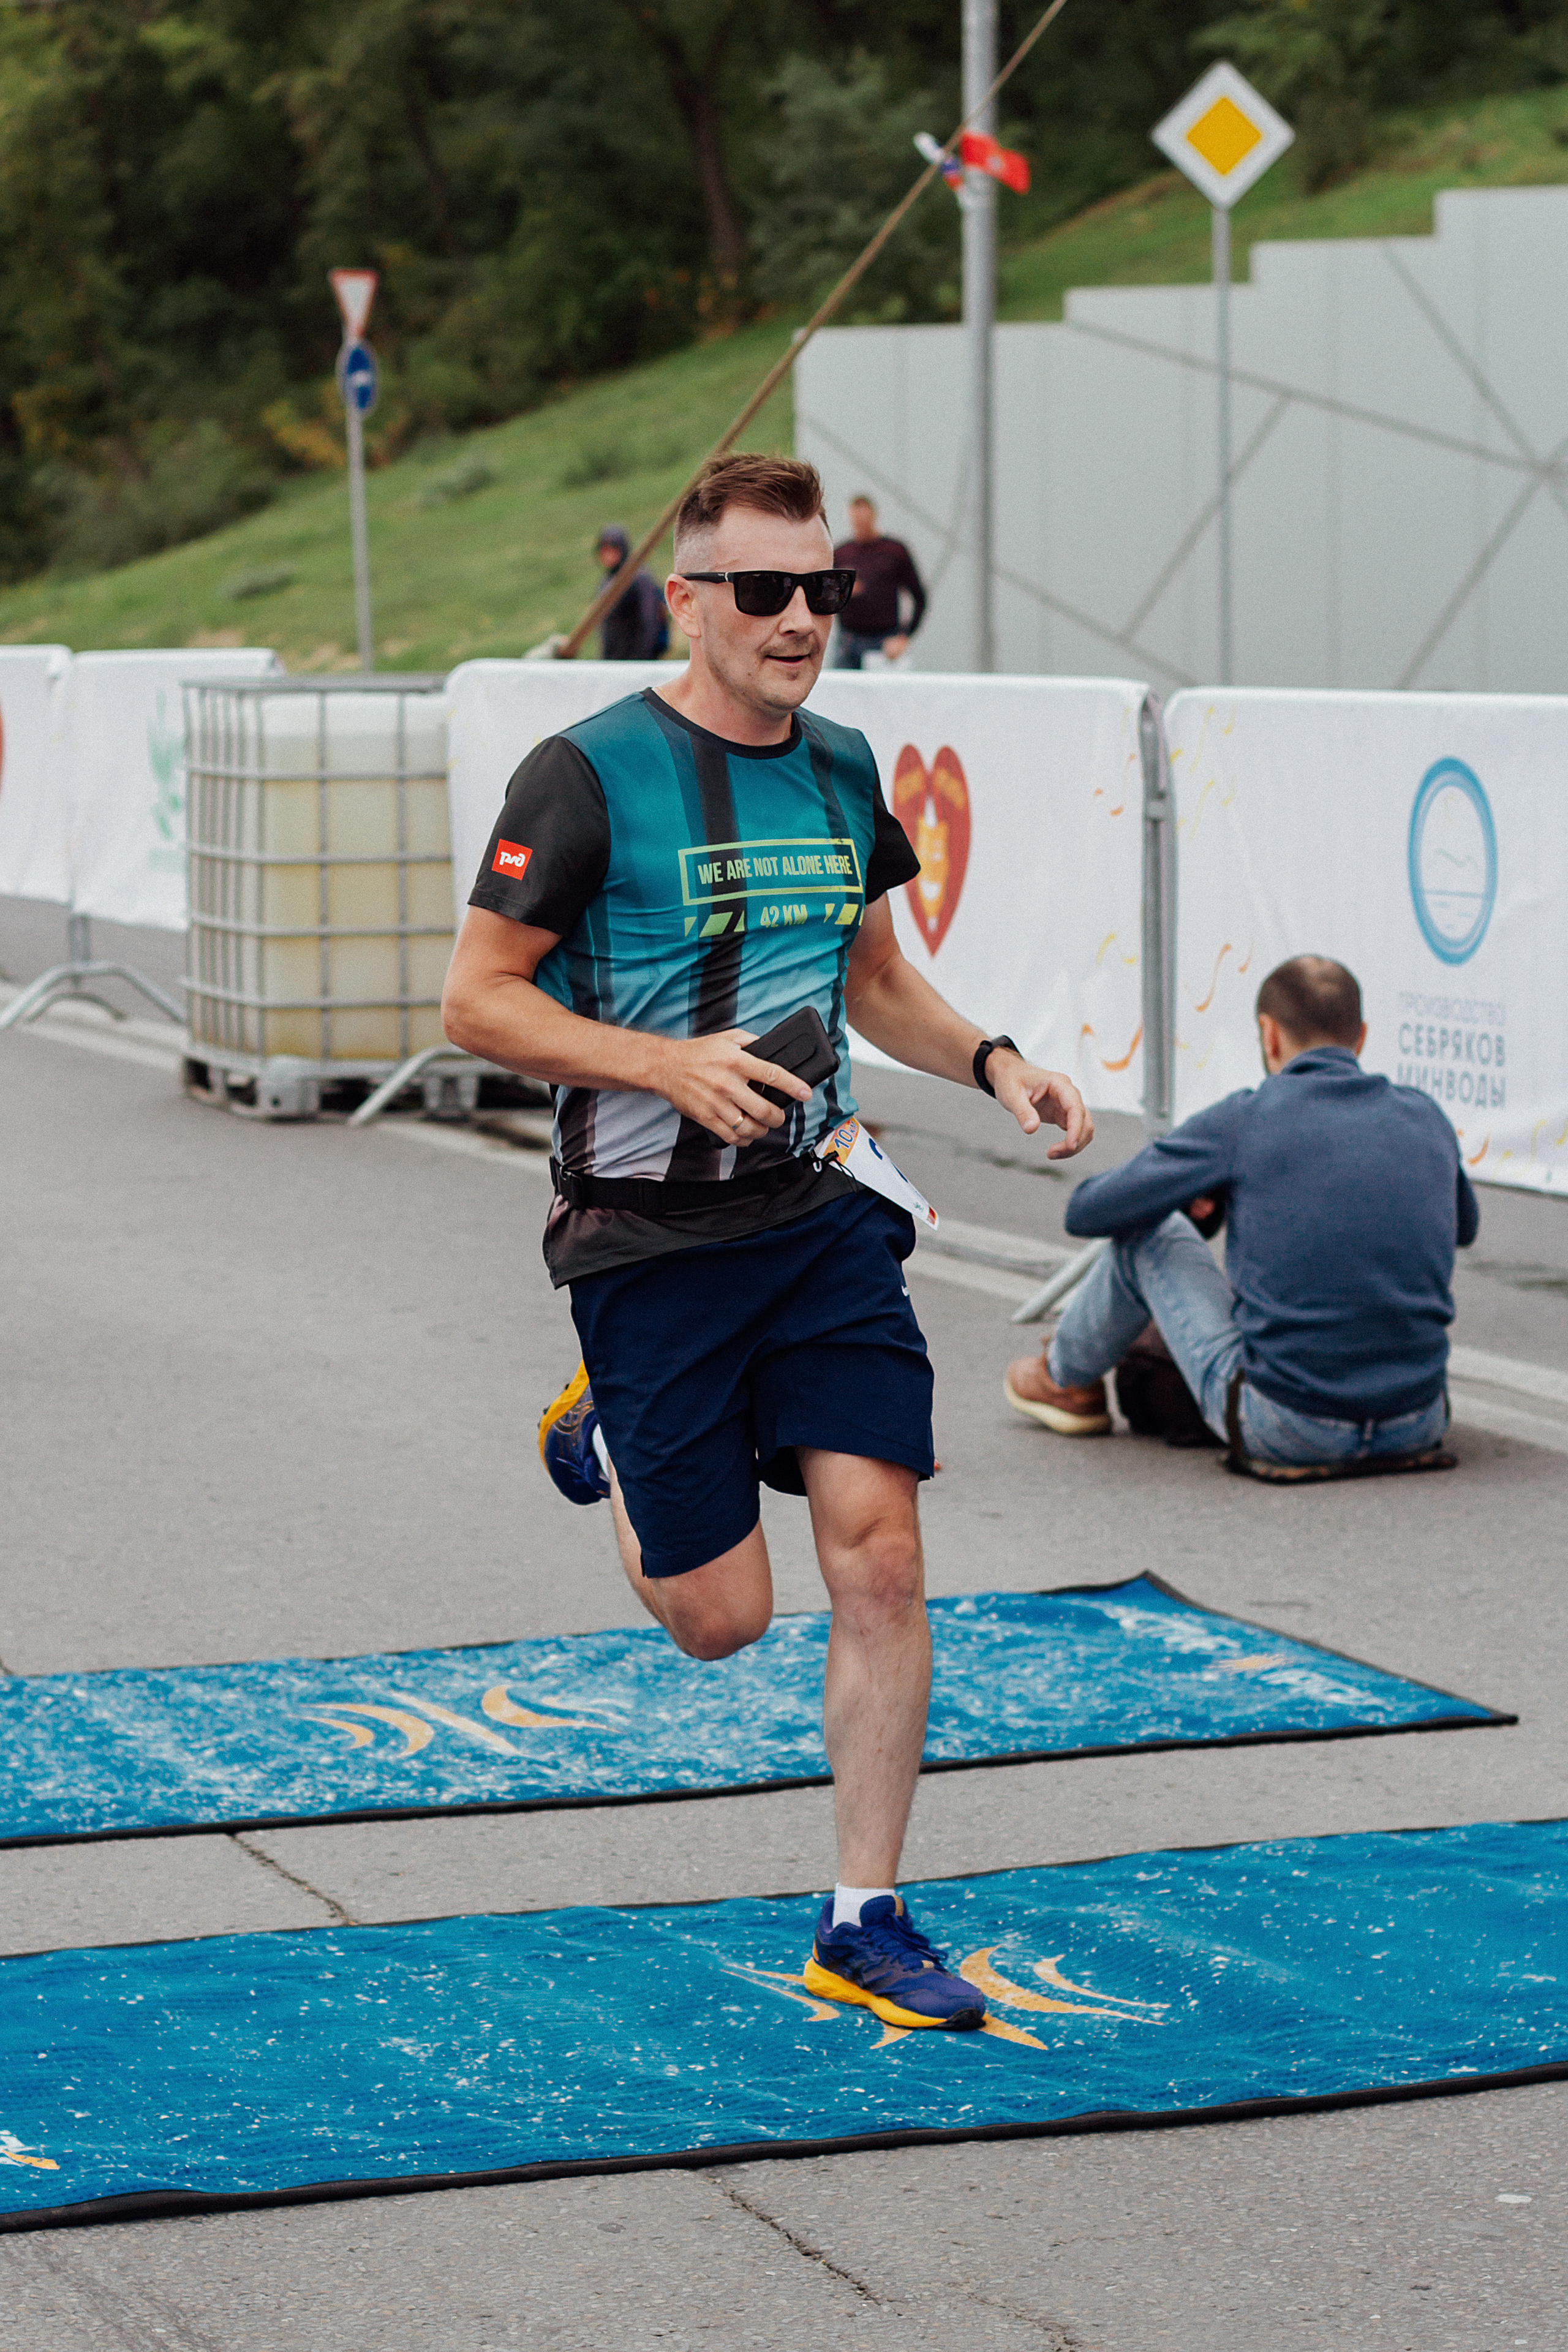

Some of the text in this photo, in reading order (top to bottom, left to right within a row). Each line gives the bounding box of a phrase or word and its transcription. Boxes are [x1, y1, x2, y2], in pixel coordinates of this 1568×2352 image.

[698, 855, 853, 884] WE ARE NOT ALONE HERE
[760, 905, 808, 928] 42 KM
[1398, 1022, 1506, 1067] СЕБРЯКОВ
[834, 1129, 853, 1148] 10
